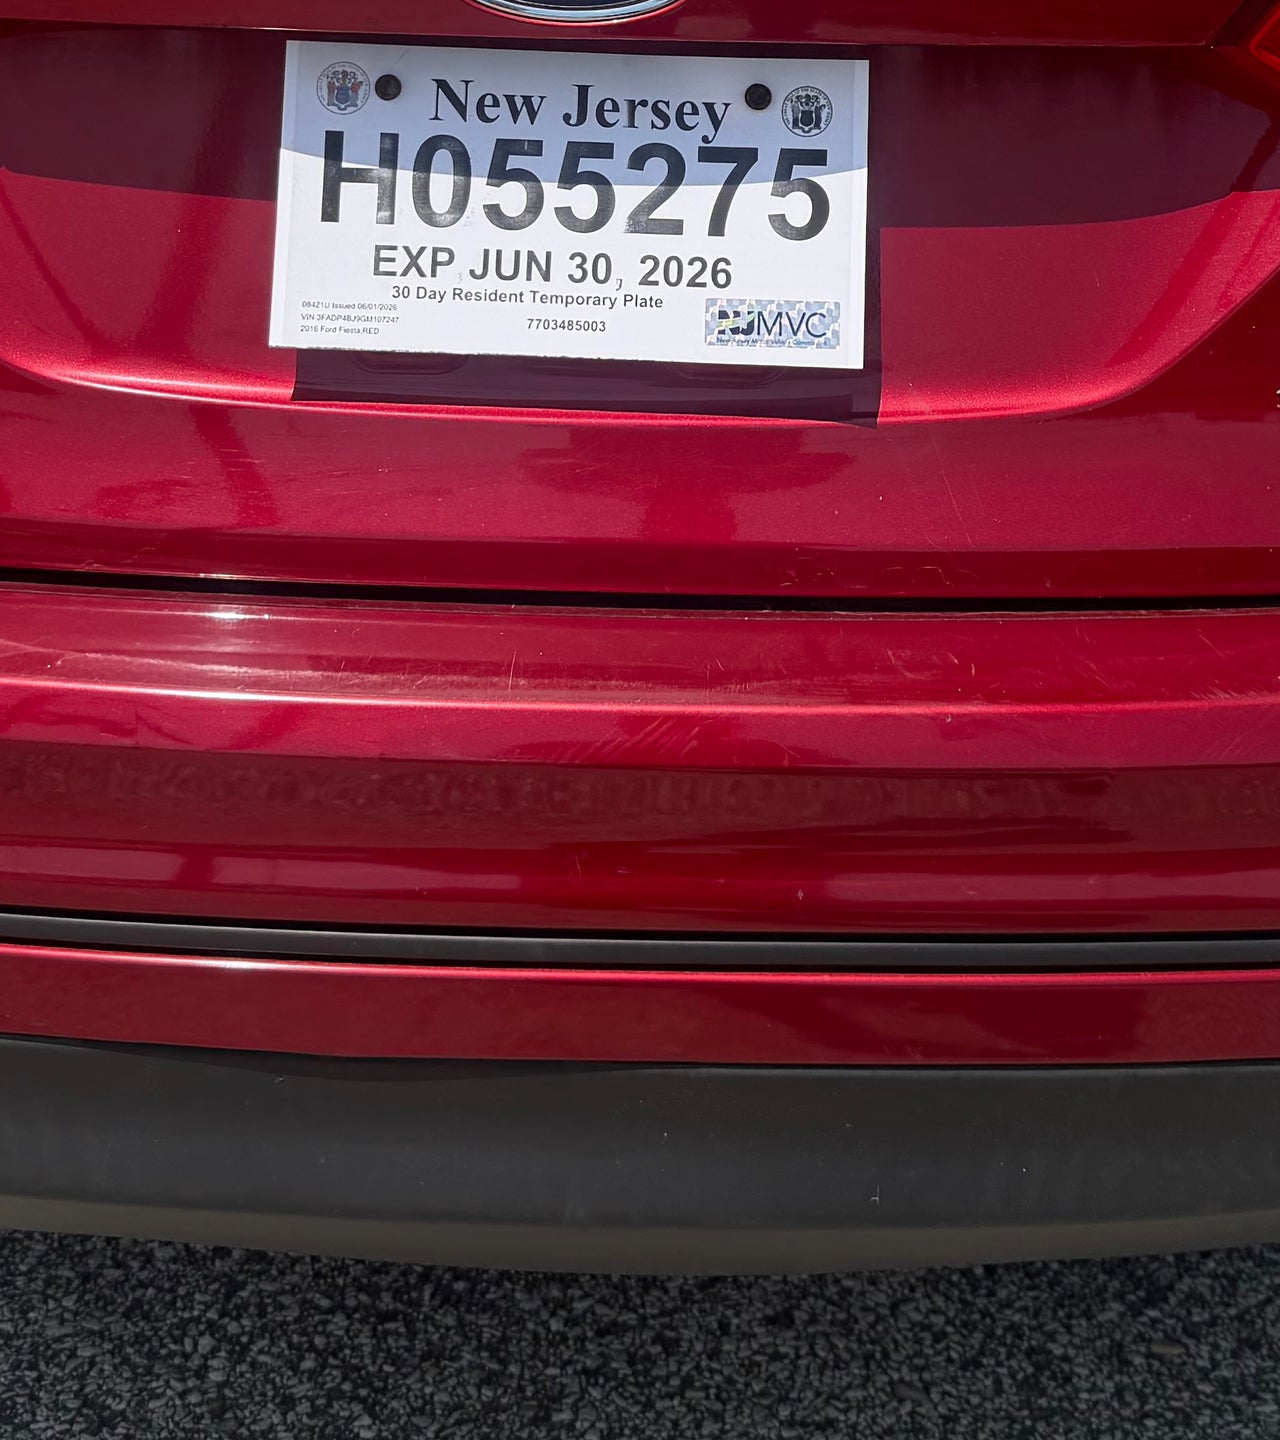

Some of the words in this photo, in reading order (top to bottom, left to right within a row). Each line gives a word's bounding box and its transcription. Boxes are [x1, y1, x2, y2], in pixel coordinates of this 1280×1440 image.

[429, 78, 547, 126] New
[562, 84, 732, 144] Jersey
[319, 130, 831, 241] H055275
[372, 244, 456, 279] EXP
[469, 248, 552, 283] JUN
[567, 252, 623, 291] 30,
[638, 255, 733, 289] 2026
[392, 285, 411, 299] 30
[416, 286, 447, 303] Day
[452, 287, 525, 303] Resident
[529, 290, 618, 310] Temporary
[623, 294, 664, 308] Plate
[300, 324, 319, 332] 2016
[320, 325, 337, 333] Ford
[301, 313, 315, 321] VIN
[527, 318, 606, 332] 7703485003
